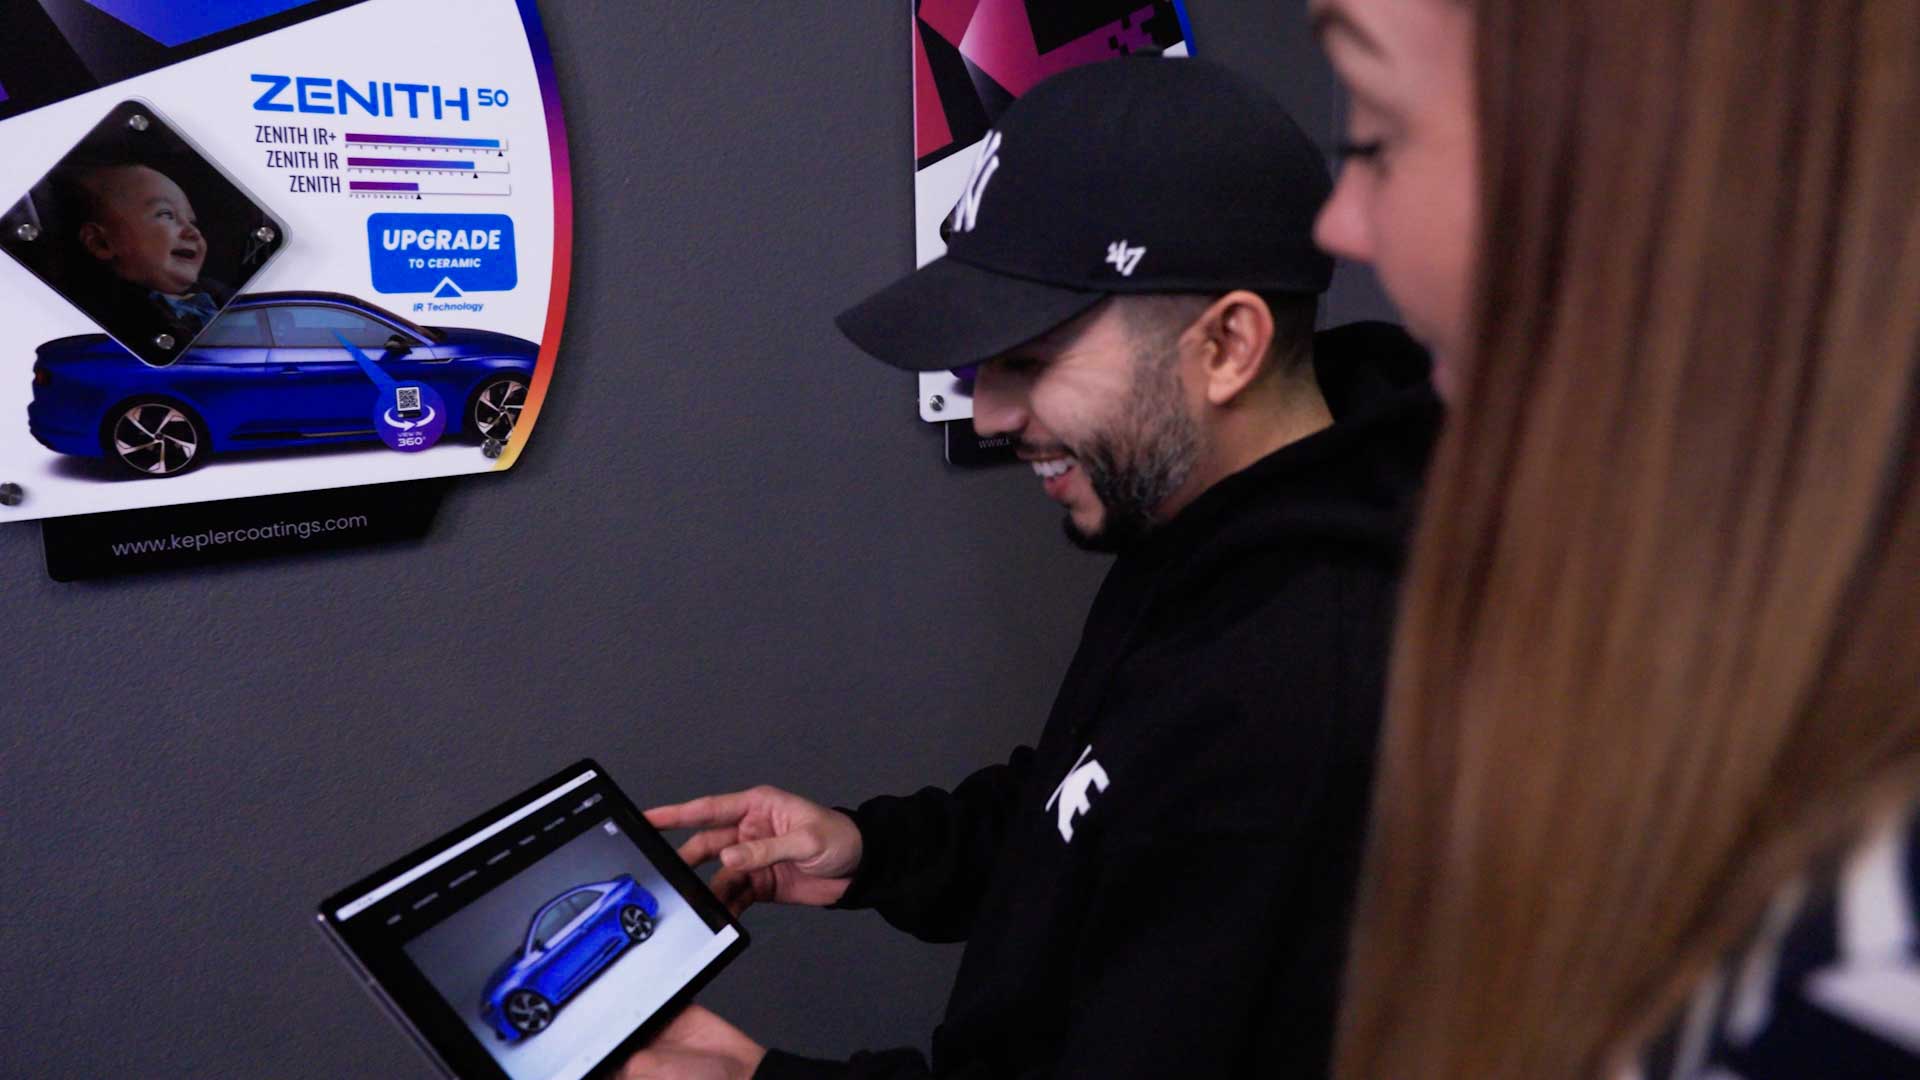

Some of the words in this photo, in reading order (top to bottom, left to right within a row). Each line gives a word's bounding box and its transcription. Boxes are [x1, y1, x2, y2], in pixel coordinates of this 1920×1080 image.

[250, 73, 470, 121] ZENITH
[477, 88, 509, 107] 50
[255, 125, 308, 145] ZENITH
[313, 127, 337, 145] IR+
[265, 150, 320, 169] ZENITH
[323, 152, 339, 169] IR
[289, 175, 342, 193] ZENITH
[382, 228, 502, 251] UPGRADE
[408, 258, 425, 269] TO
[427, 257, 482, 269] CERAMIC
[412, 303, 424, 312] IR
[426, 302, 484, 313] Technology
[111, 513, 368, 557] www.keplercoatings.com
